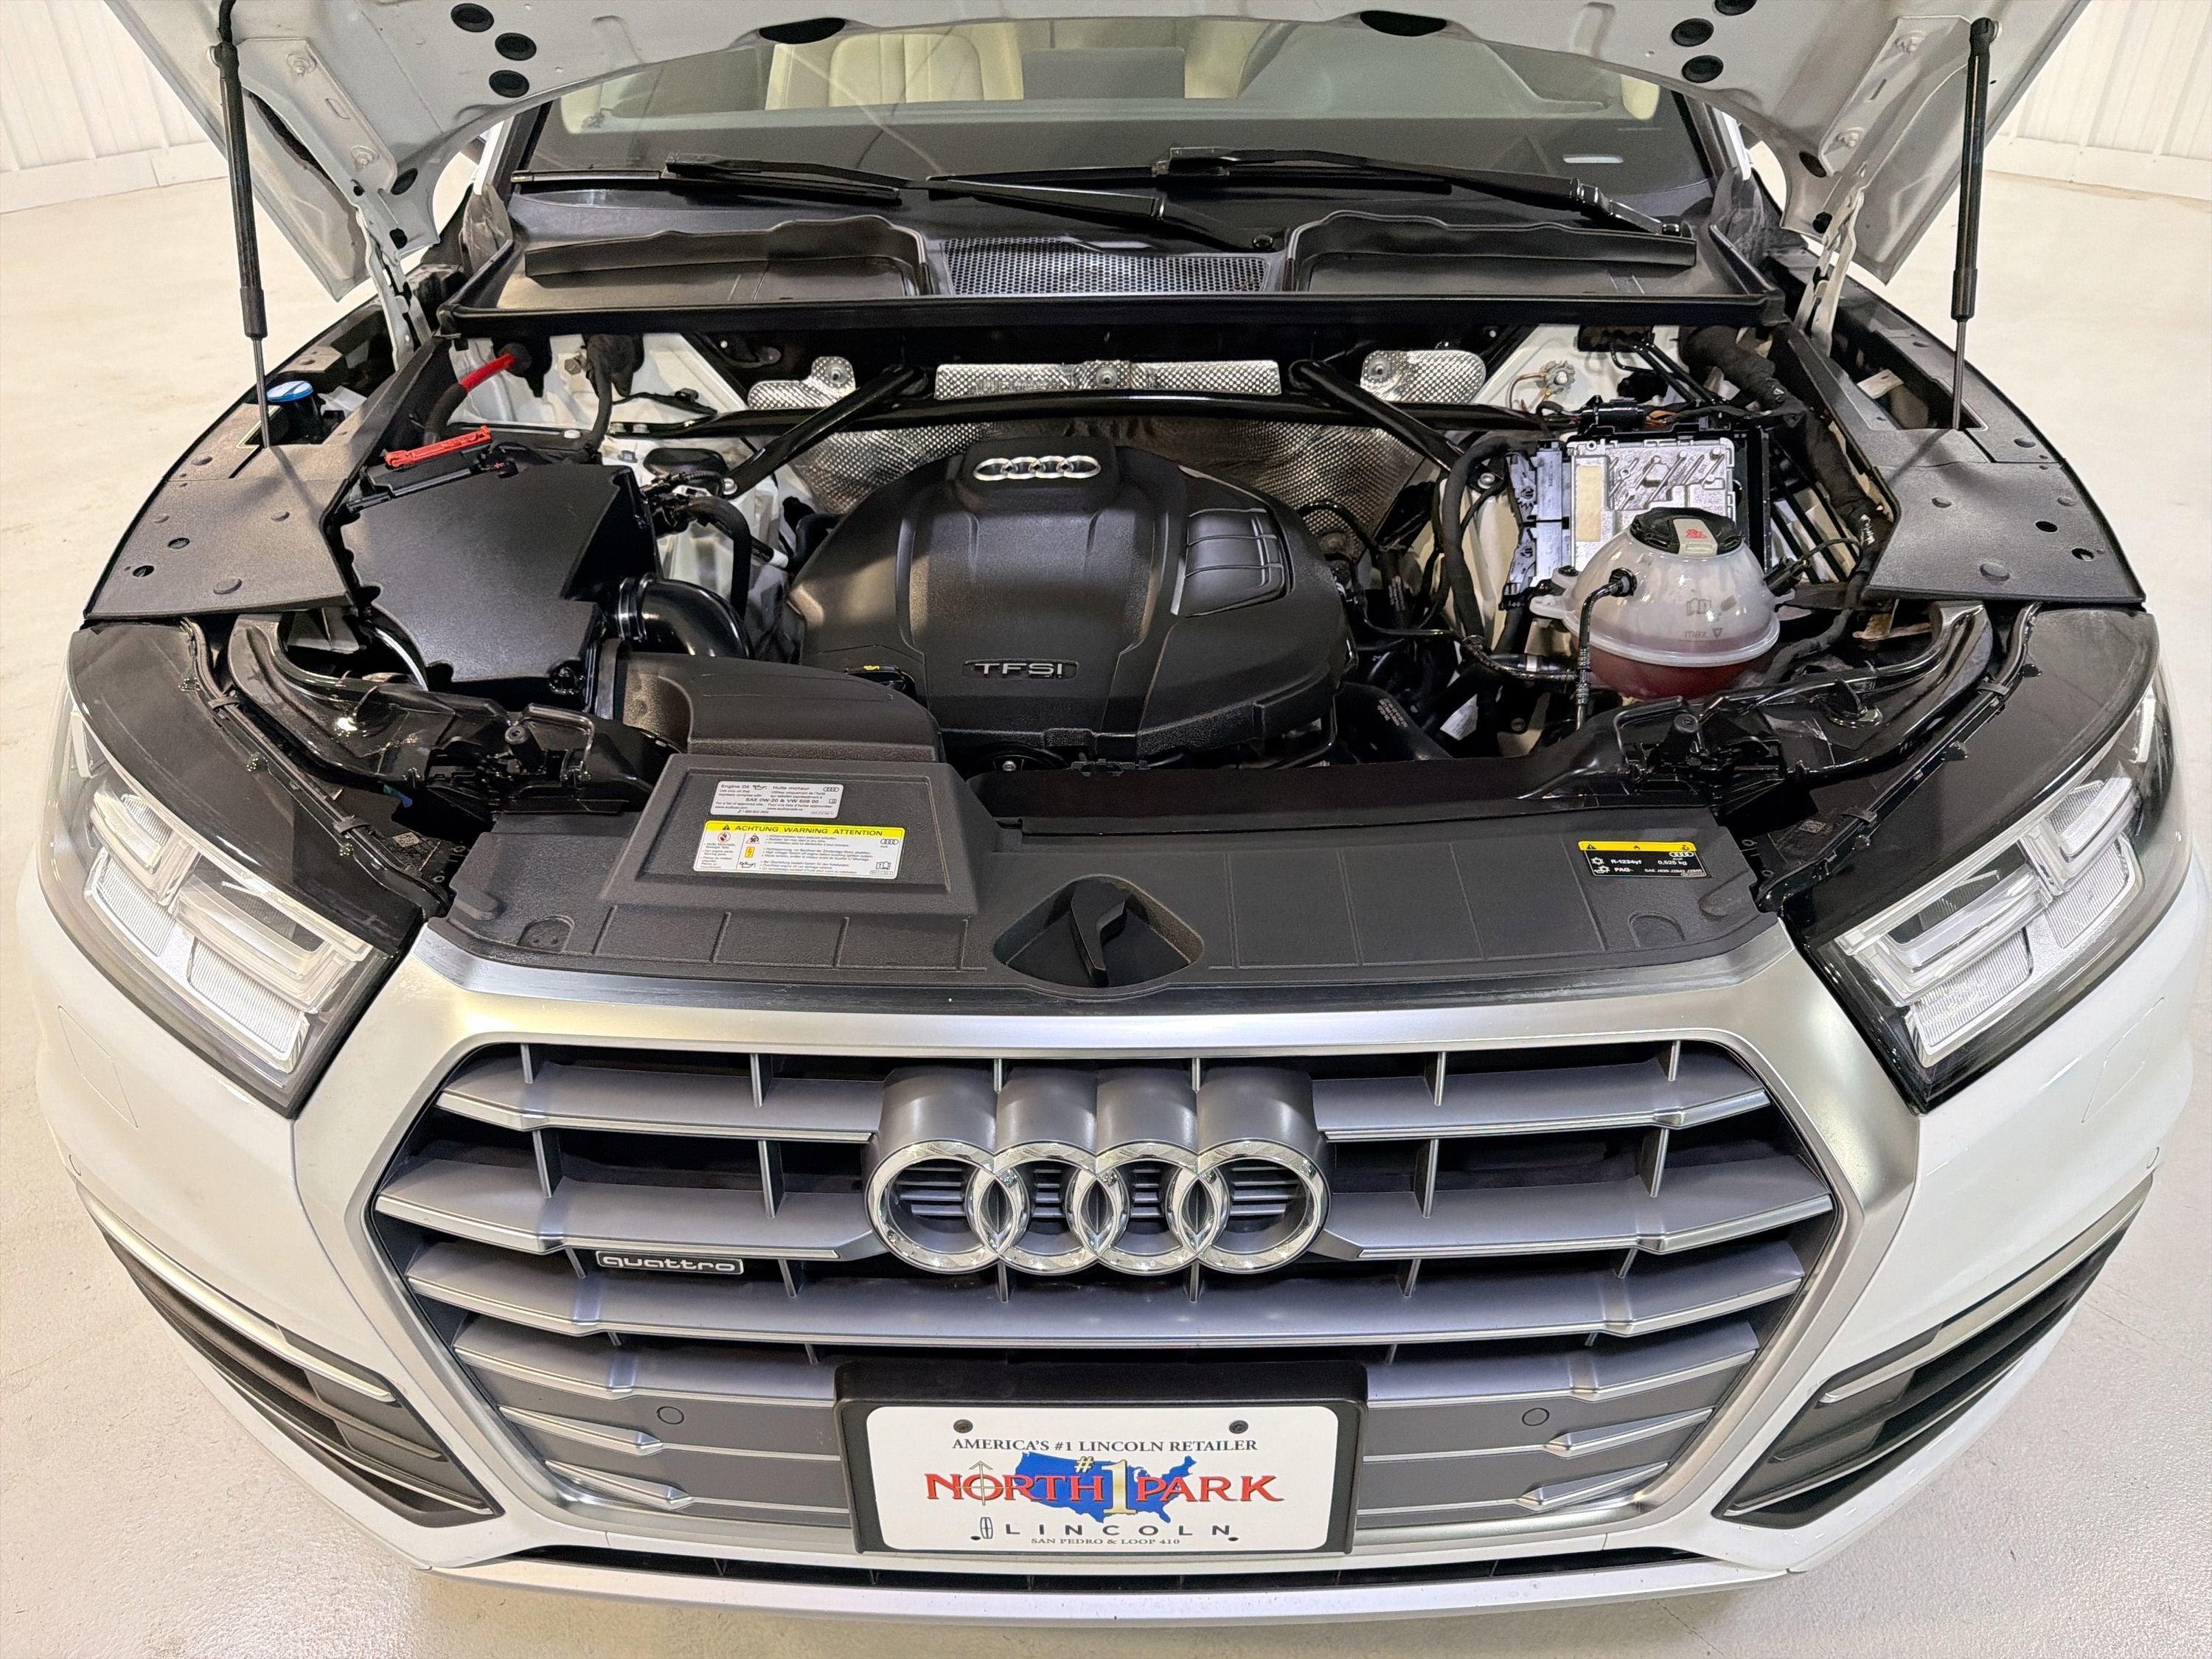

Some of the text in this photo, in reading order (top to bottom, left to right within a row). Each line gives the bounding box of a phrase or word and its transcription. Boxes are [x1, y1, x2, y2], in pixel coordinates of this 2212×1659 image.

[1684, 630, 1707, 639] max
[975, 663, 1063, 676] TFSI
[602, 1255, 736, 1271] quattro
[952, 1439, 1258, 1452] AMERICA'S #1 LINCOLN RETAILER
[924, 1473, 1105, 1502] NORTH
[1135, 1475, 1286, 1503] PARK
[1005, 1524, 1231, 1537] LINCOLN
